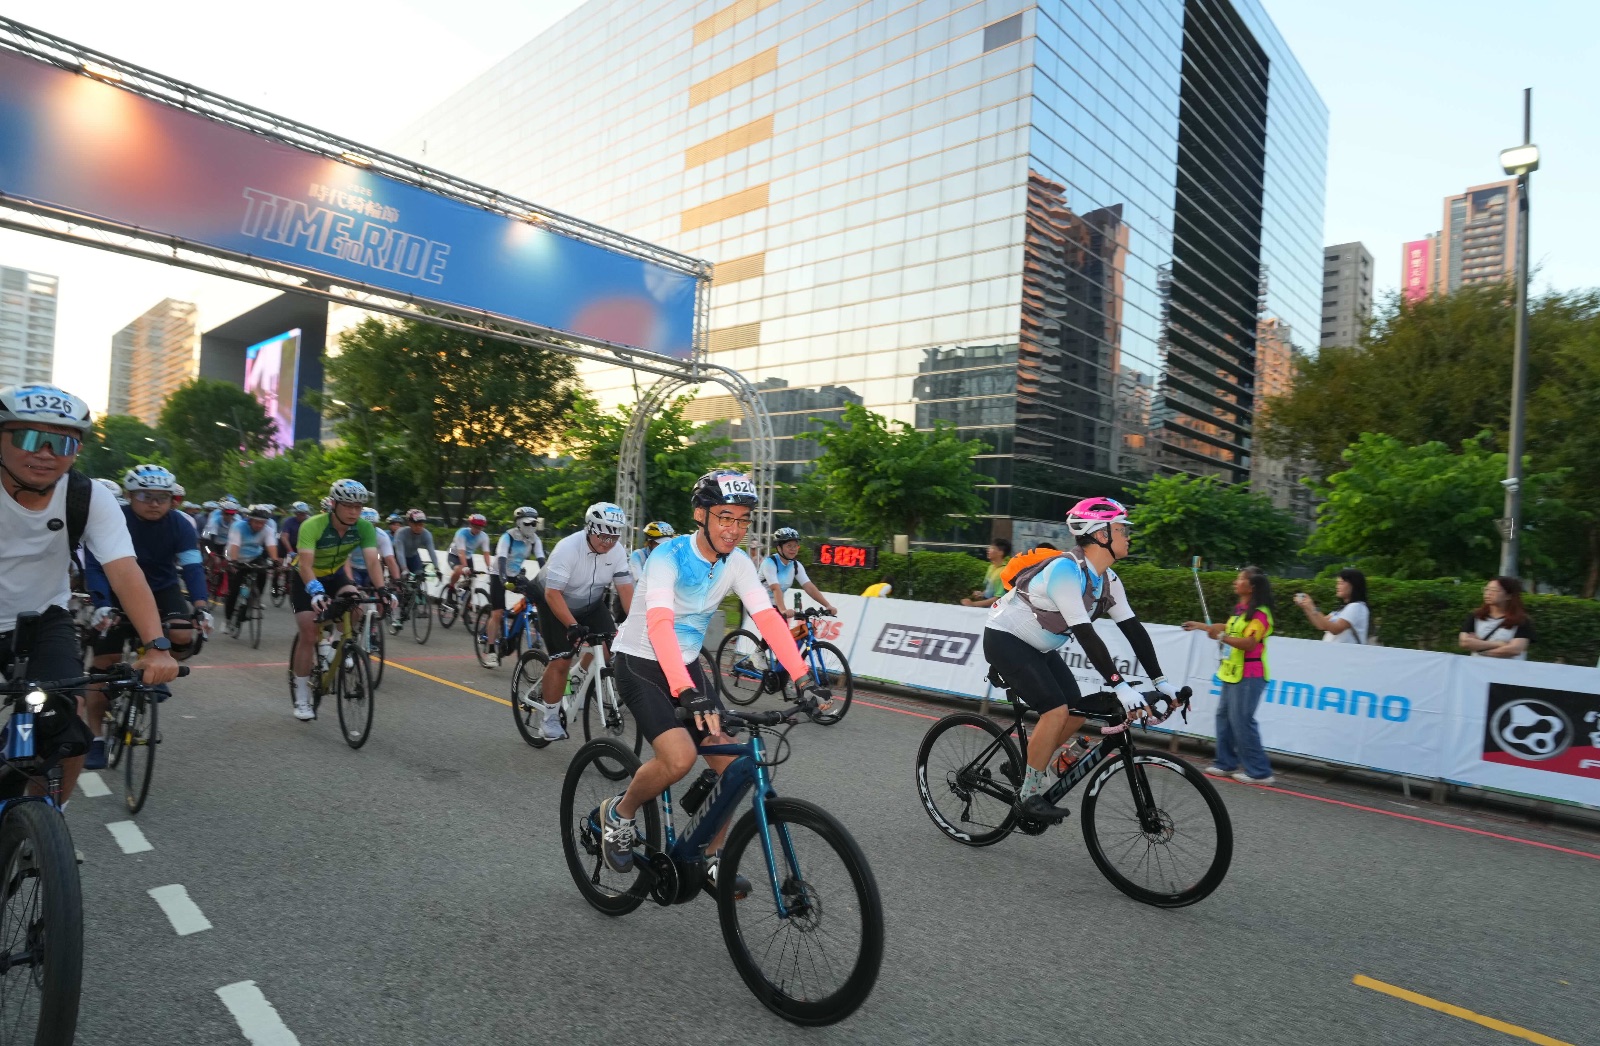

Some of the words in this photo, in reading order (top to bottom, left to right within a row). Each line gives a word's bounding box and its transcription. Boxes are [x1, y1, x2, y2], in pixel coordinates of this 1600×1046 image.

[241, 186, 355, 260] TIME
[362, 220, 451, 285] RIDE
[21, 394, 73, 415] 1326
[878, 628, 972, 660] BETO
[1209, 673, 1412, 723] IMANO
[1051, 744, 1103, 799] GIANT
